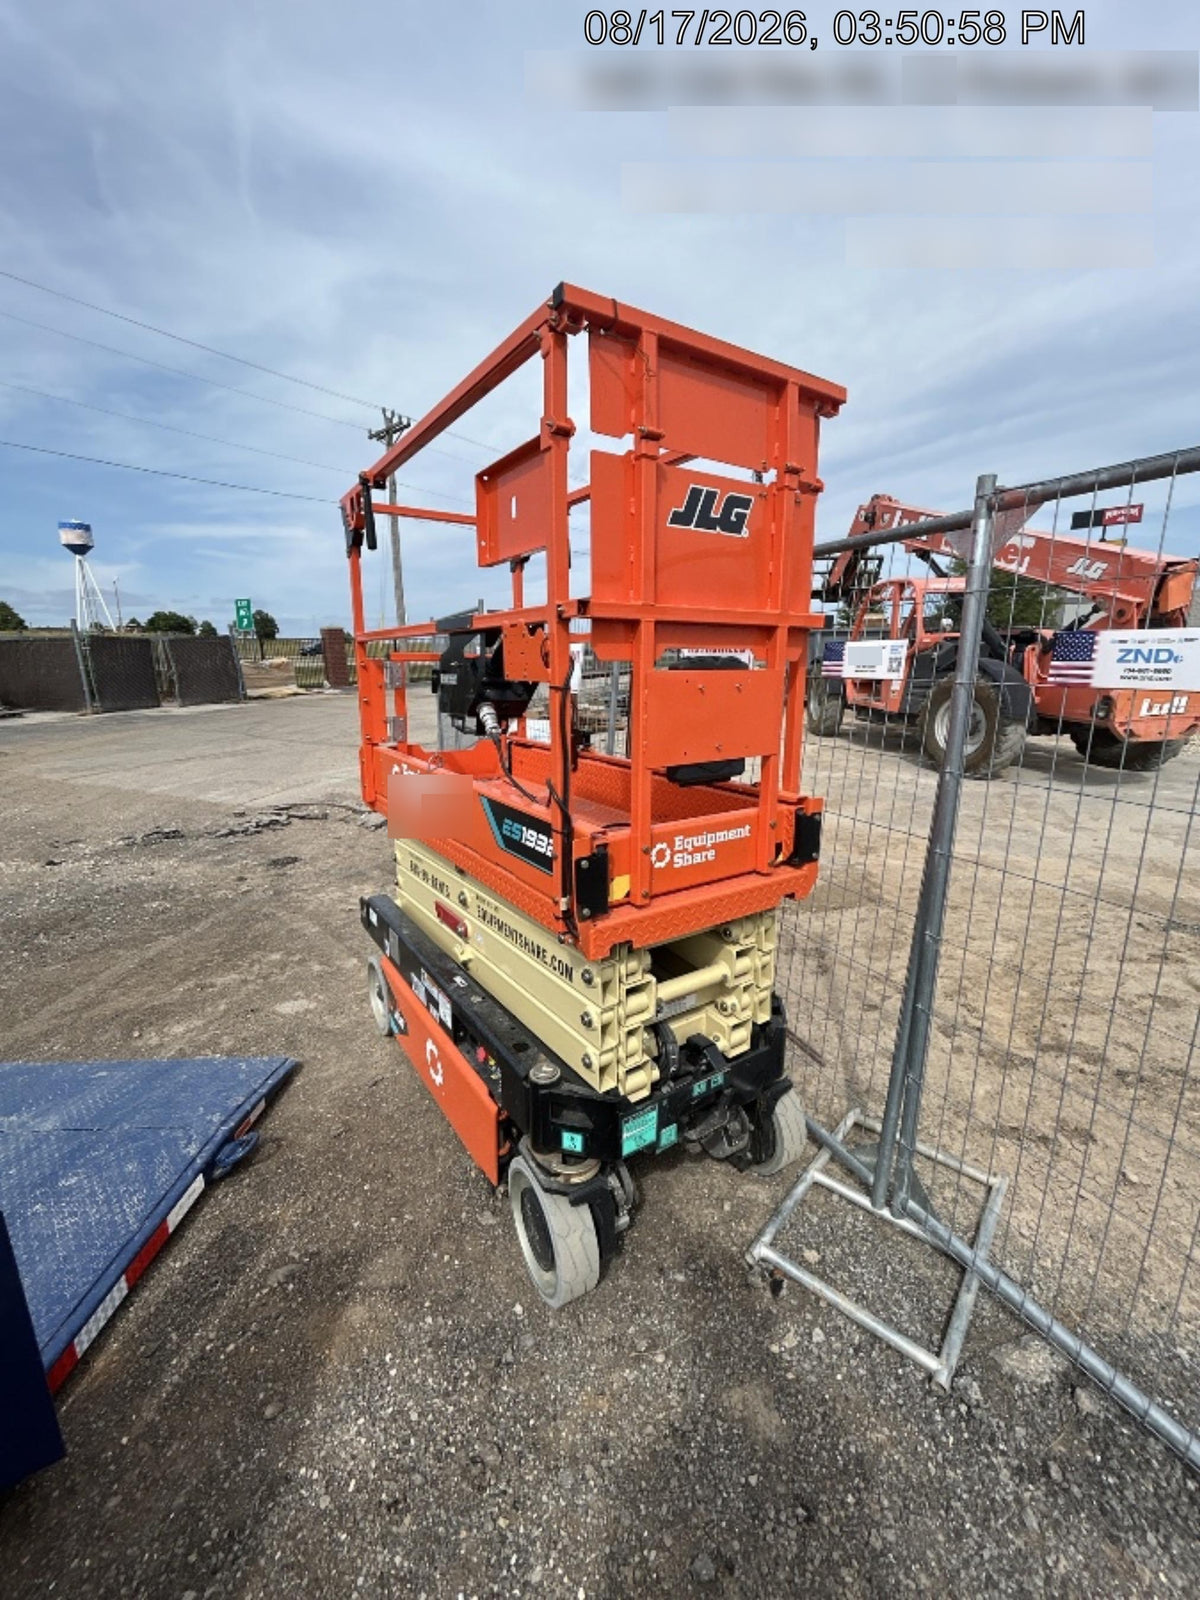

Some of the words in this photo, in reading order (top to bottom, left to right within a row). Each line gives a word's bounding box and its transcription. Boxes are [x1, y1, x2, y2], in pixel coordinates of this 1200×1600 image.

[666, 484, 755, 537] JLG
[1066, 557, 1109, 580] JLG
[1116, 648, 1175, 664] ZND
[673, 824, 752, 852] Equipment
[672, 849, 716, 869] Share
